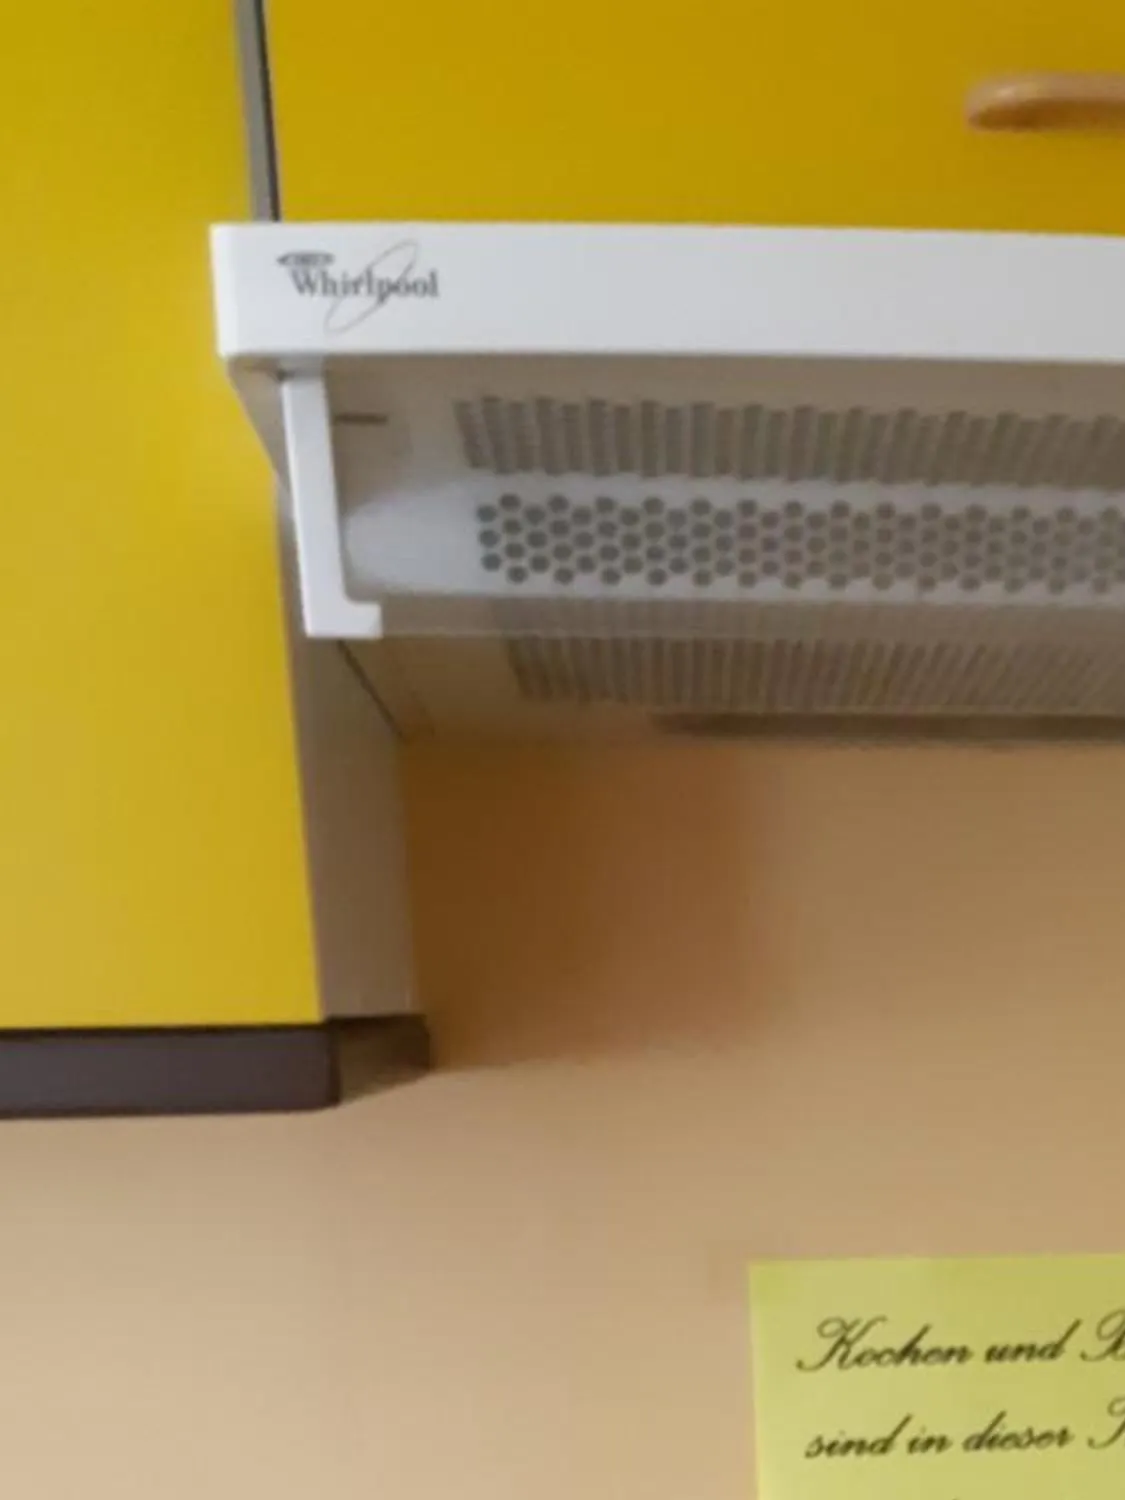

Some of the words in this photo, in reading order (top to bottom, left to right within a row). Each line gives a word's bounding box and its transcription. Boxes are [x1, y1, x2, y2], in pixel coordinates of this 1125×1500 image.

[287, 268, 439, 304] Whirlpool
[796, 1316, 974, 1372] Kochen
[984, 1319, 1083, 1363] und
[805, 1414, 914, 1460] sind
[906, 1425, 953, 1455] in
[962, 1411, 1075, 1454] dieser
